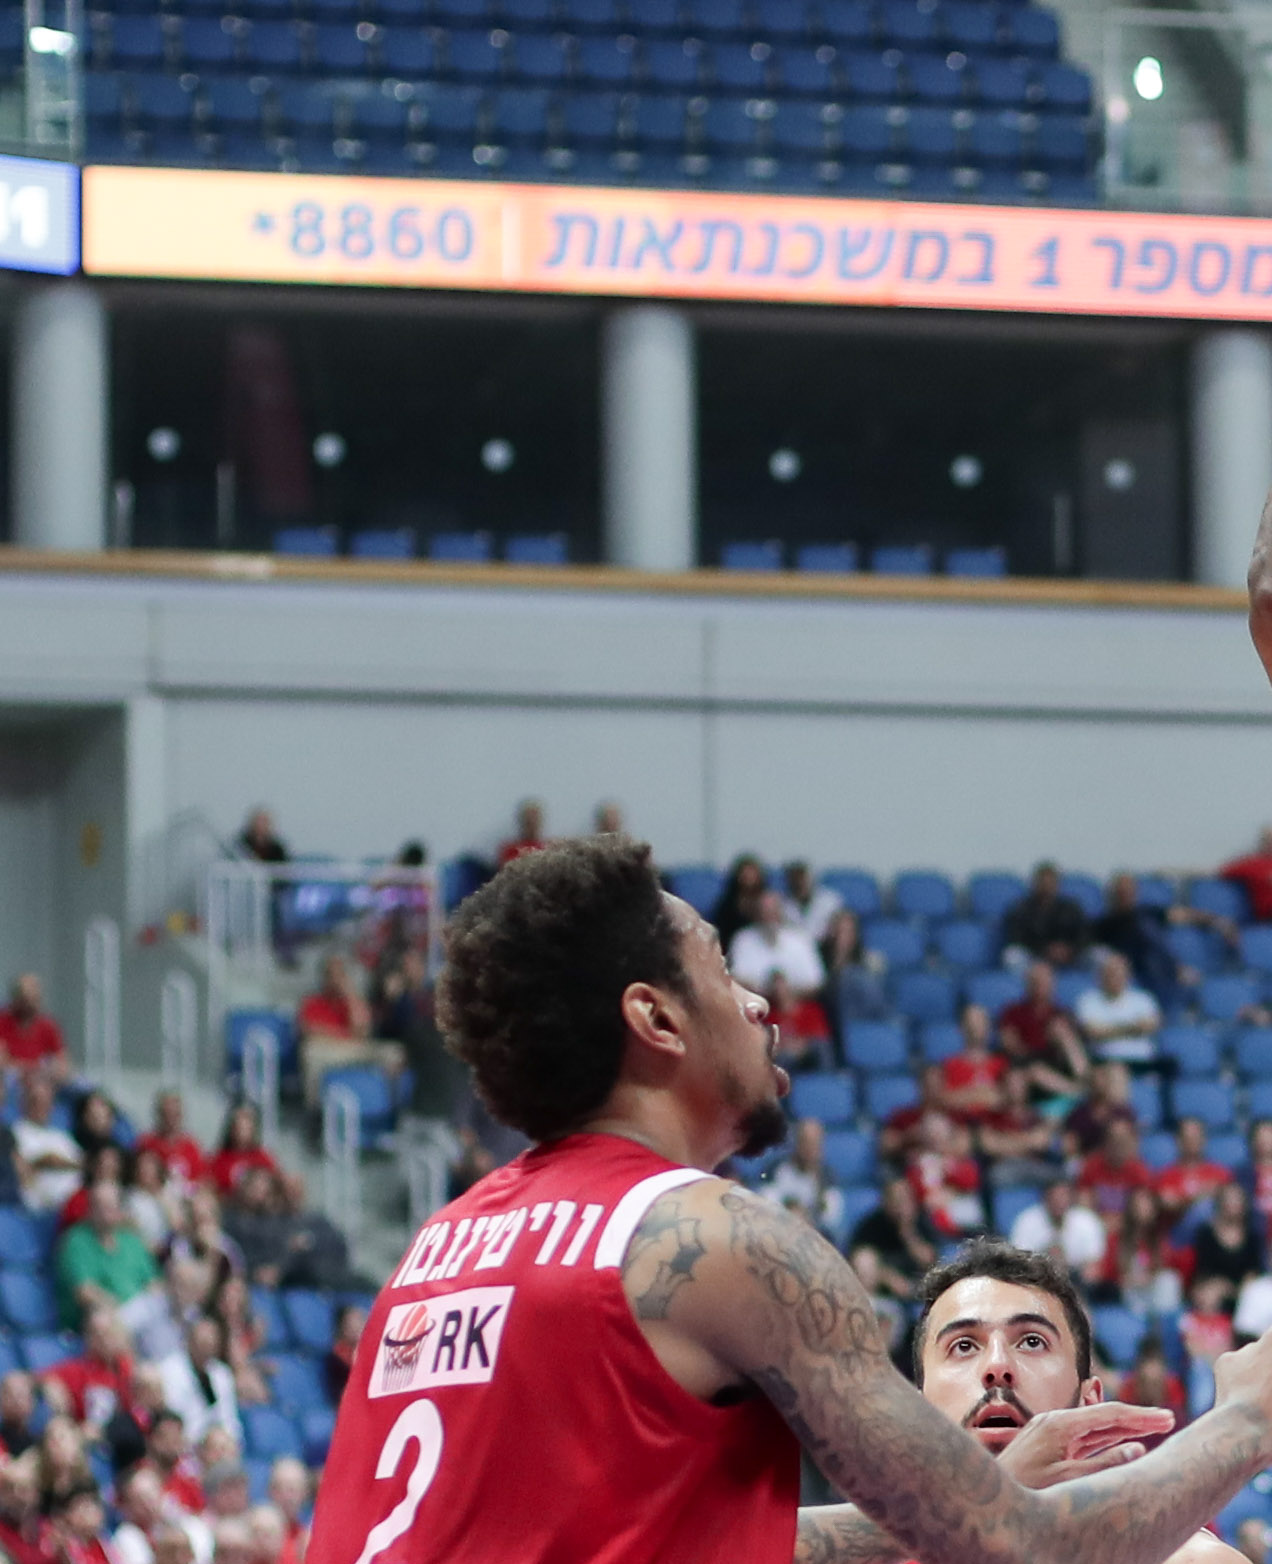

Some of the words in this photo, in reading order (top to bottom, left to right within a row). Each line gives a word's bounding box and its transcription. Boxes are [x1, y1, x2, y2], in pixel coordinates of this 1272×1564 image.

[547, 212, 995, 284] במשכנתאות
[1030, 235, 1060, 288] 1
[431, 1303, 503, 1374] RK
